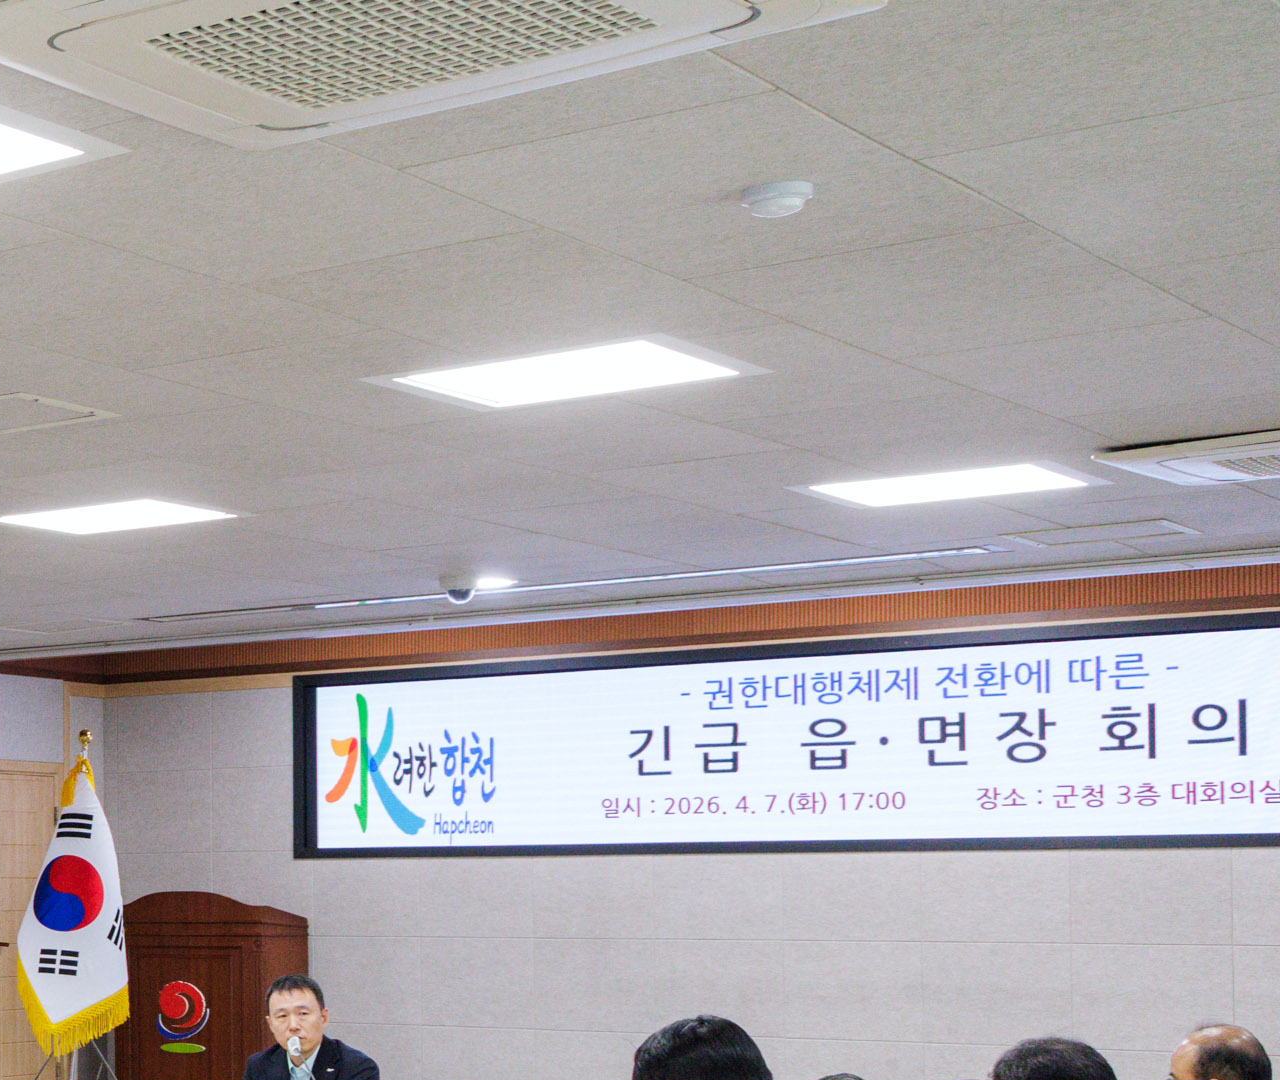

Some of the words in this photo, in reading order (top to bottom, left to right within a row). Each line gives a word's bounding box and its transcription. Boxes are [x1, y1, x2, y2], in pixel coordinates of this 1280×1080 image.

[703, 666, 919, 711] 권한대행체제
[935, 658, 1051, 699] 전환에
[1067, 653, 1150, 691] 따른
[440, 729, 496, 807] 합천
[601, 796, 642, 819] 일시
[663, 796, 727, 816] 2026.
[735, 795, 756, 815] 4.
[838, 791, 907, 812] 17:00
[976, 786, 1028, 811] 장소
[1052, 784, 1104, 809] 군청
[1116, 782, 1161, 808] 3층
[433, 811, 495, 846] Hapcheon
